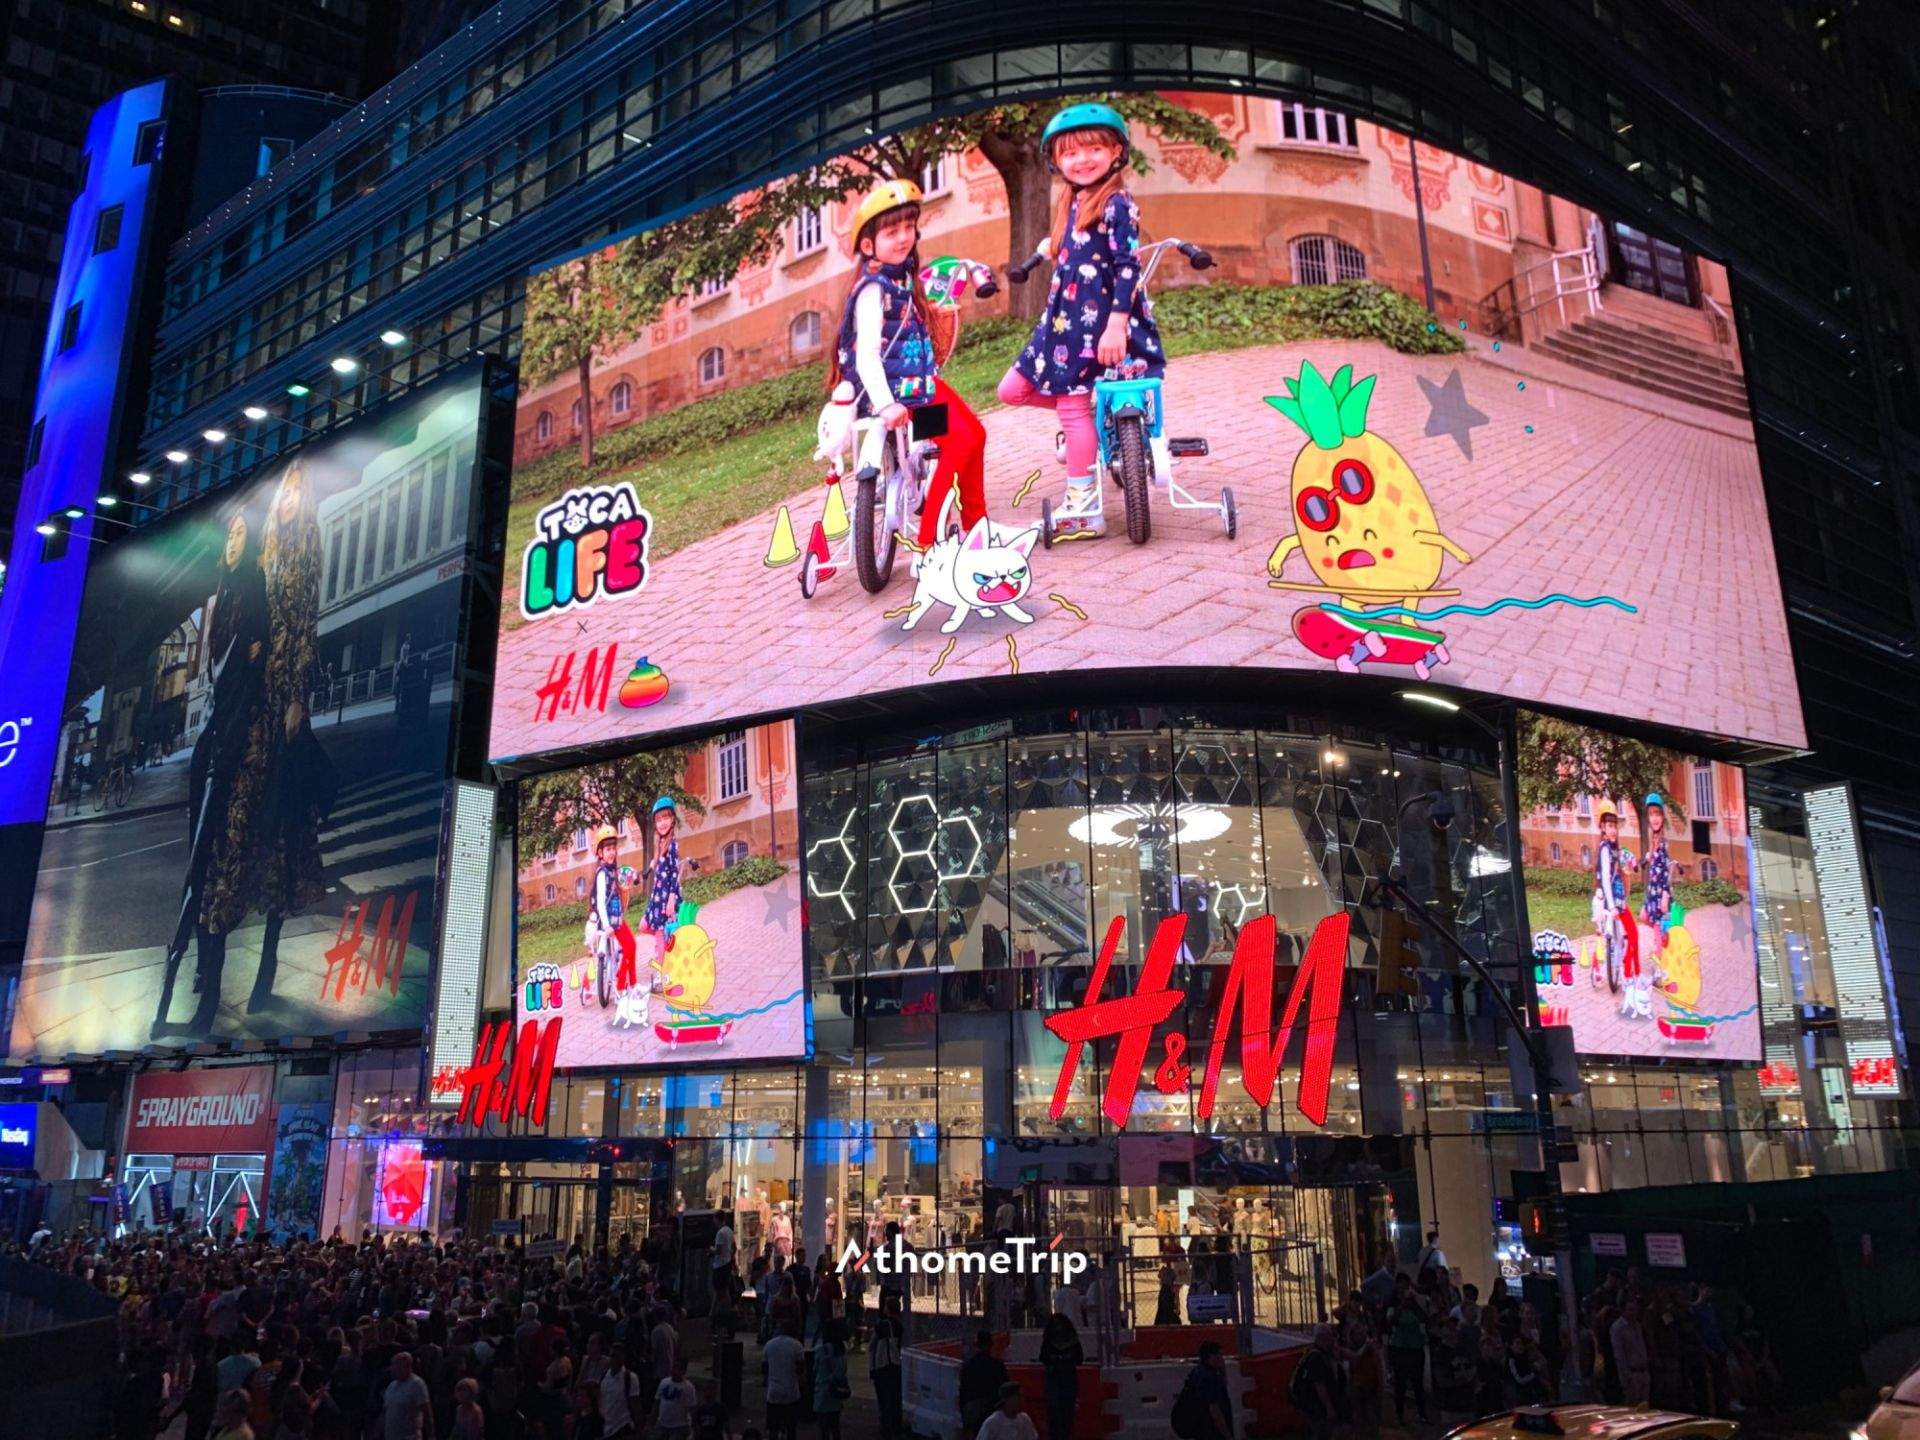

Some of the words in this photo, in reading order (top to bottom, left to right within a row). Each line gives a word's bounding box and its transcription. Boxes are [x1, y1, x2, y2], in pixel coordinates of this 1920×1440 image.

[543, 493, 633, 539] TOCA
[528, 519, 645, 610] LIFE
[534, 642, 619, 722] H&M
[320, 890, 418, 1003] H&M
[526, 980, 563, 1010] LIFE
[1043, 911, 1350, 1128] H&M
[136, 1093, 260, 1128] SPRAYGROUND
[455, 1017, 563, 1129] H&M
